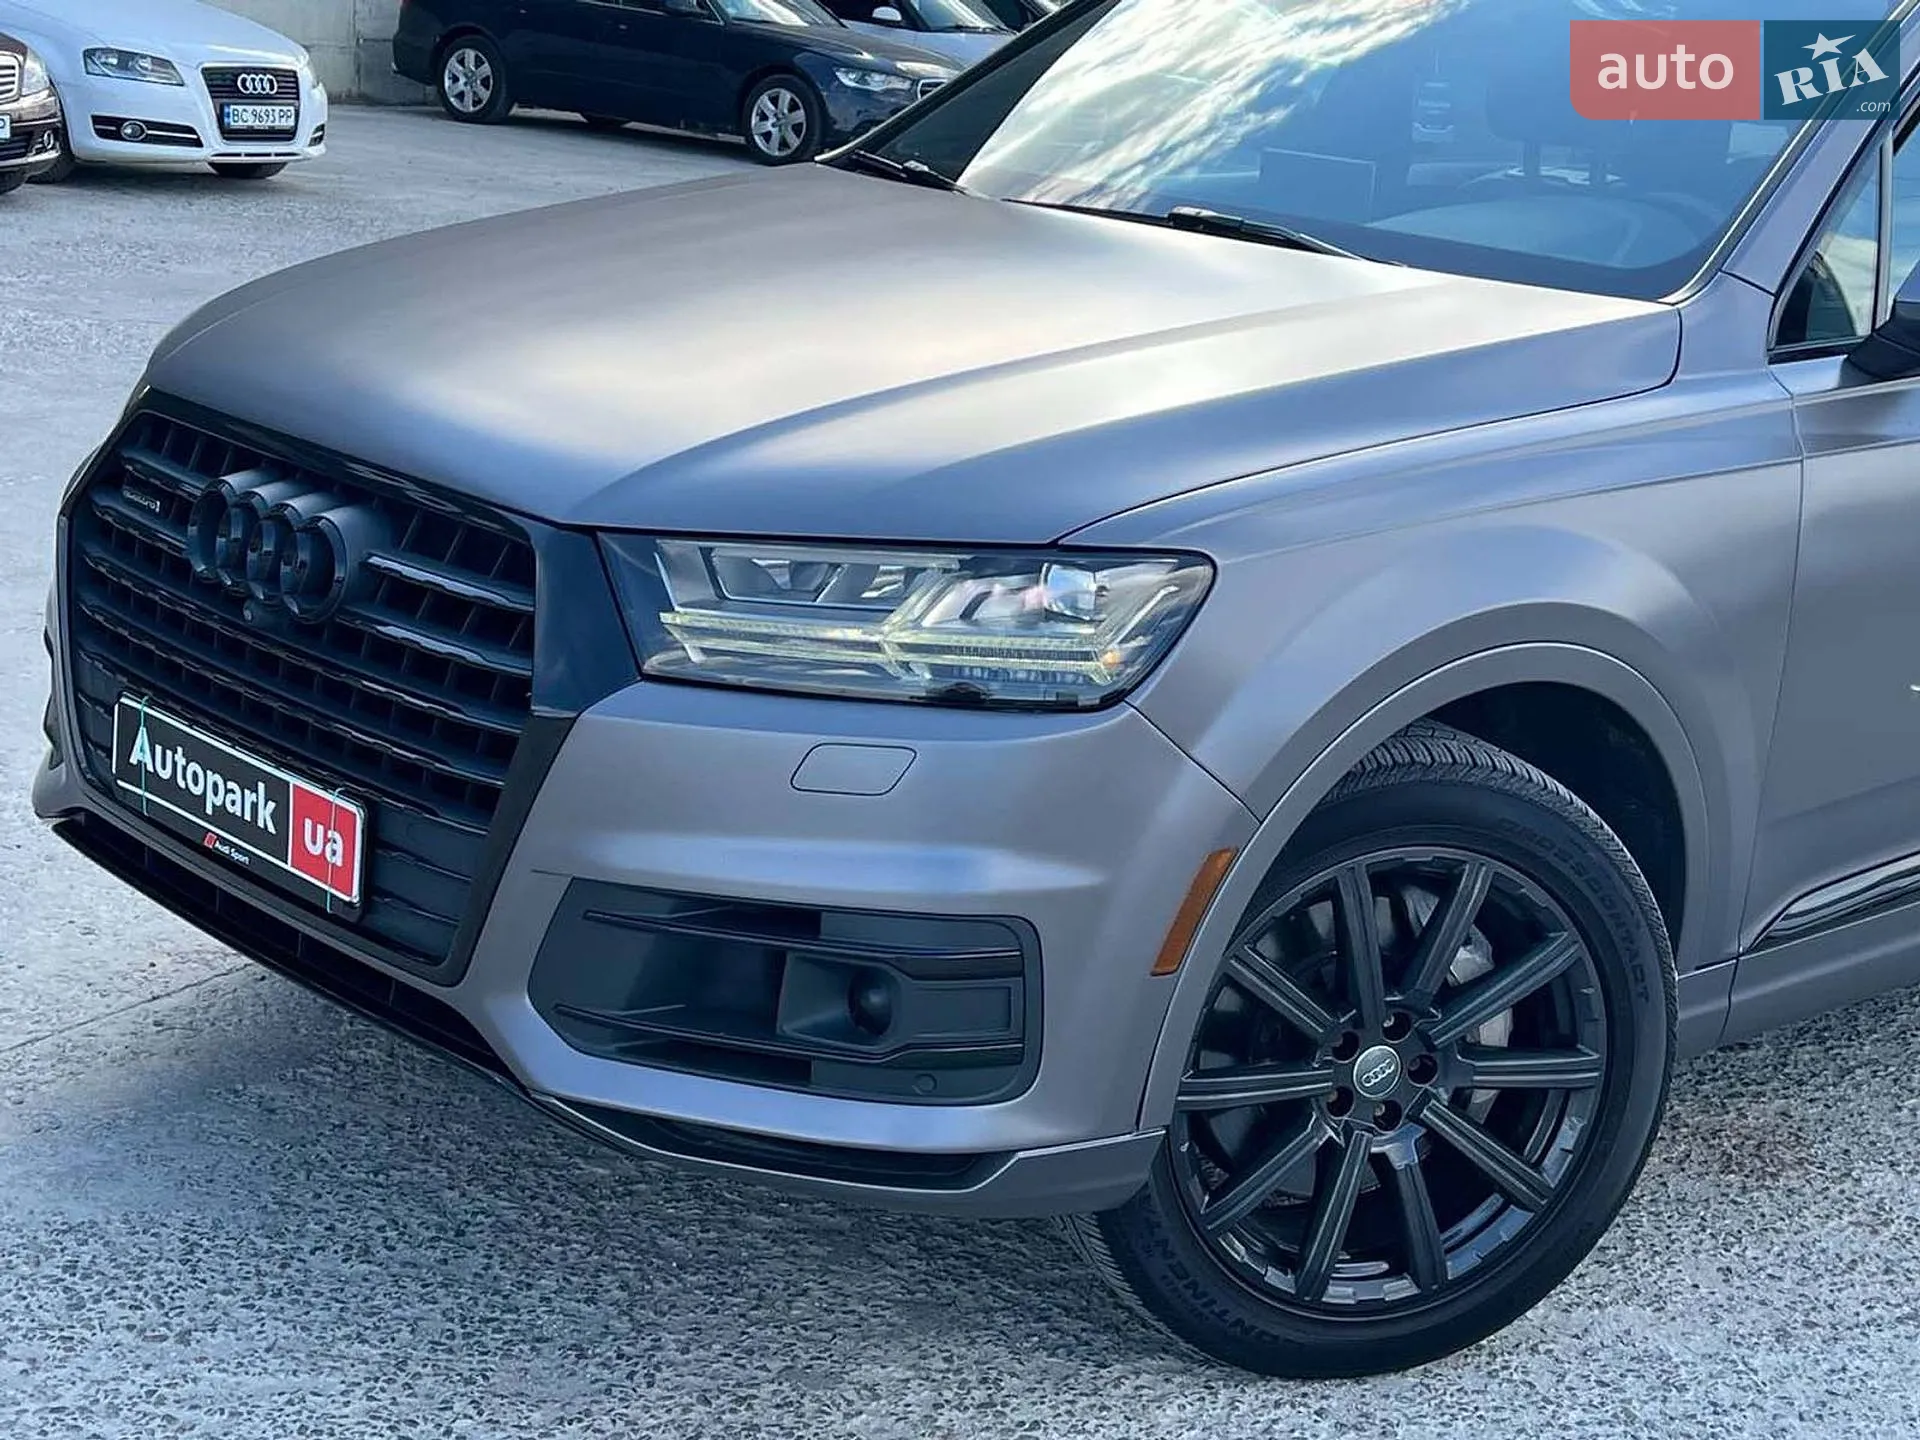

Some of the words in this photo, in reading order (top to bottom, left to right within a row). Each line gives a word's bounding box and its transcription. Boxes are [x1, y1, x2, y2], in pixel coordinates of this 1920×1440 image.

[232, 108, 249, 123] BC
[251, 108, 276, 123] 9693
[278, 108, 293, 123] PP
[129, 726, 277, 835] Autopark
[304, 817, 344, 868] ua
